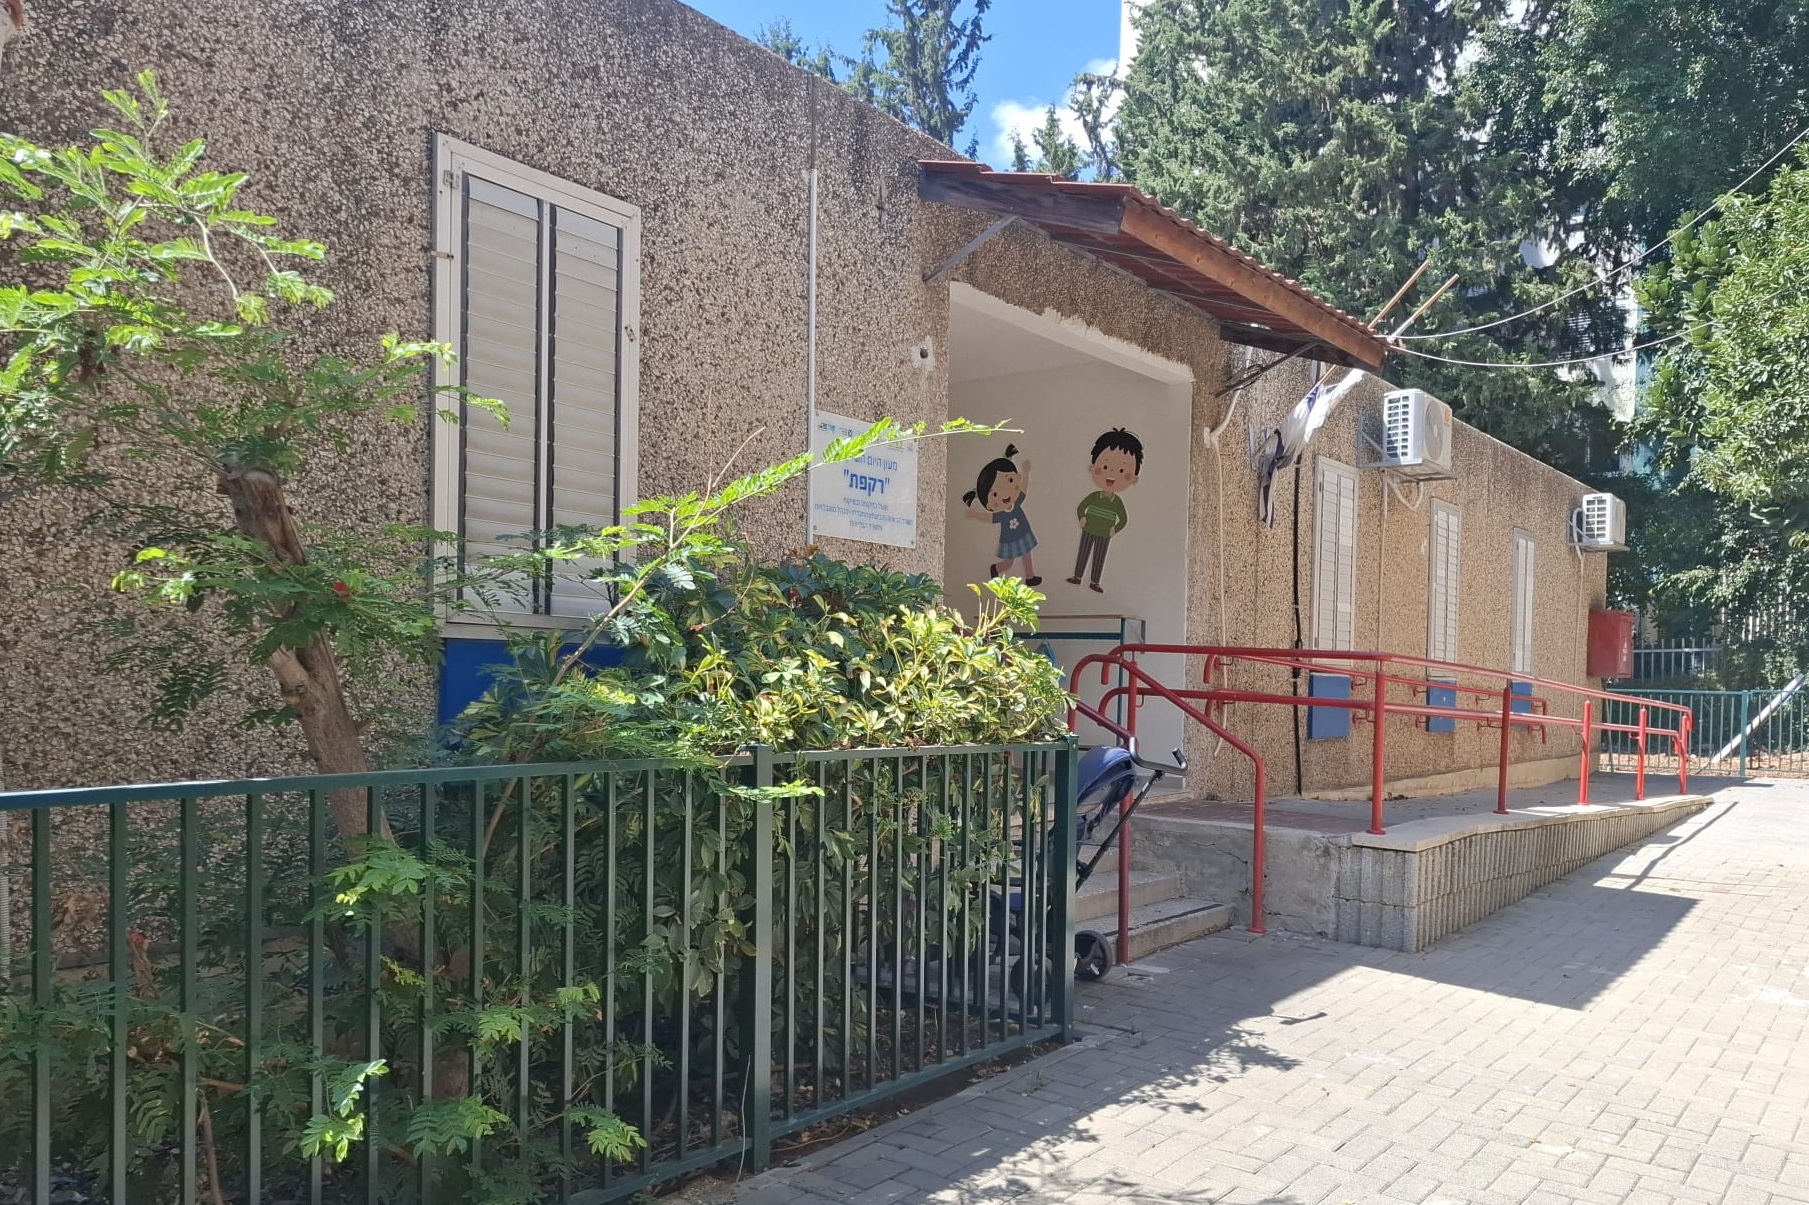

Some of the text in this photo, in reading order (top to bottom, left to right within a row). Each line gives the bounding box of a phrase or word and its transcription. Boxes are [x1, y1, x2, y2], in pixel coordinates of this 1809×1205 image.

[867, 456, 882, 468] היום
[883, 459, 898, 471] מעון
[843, 469, 890, 497] "רקפת"
